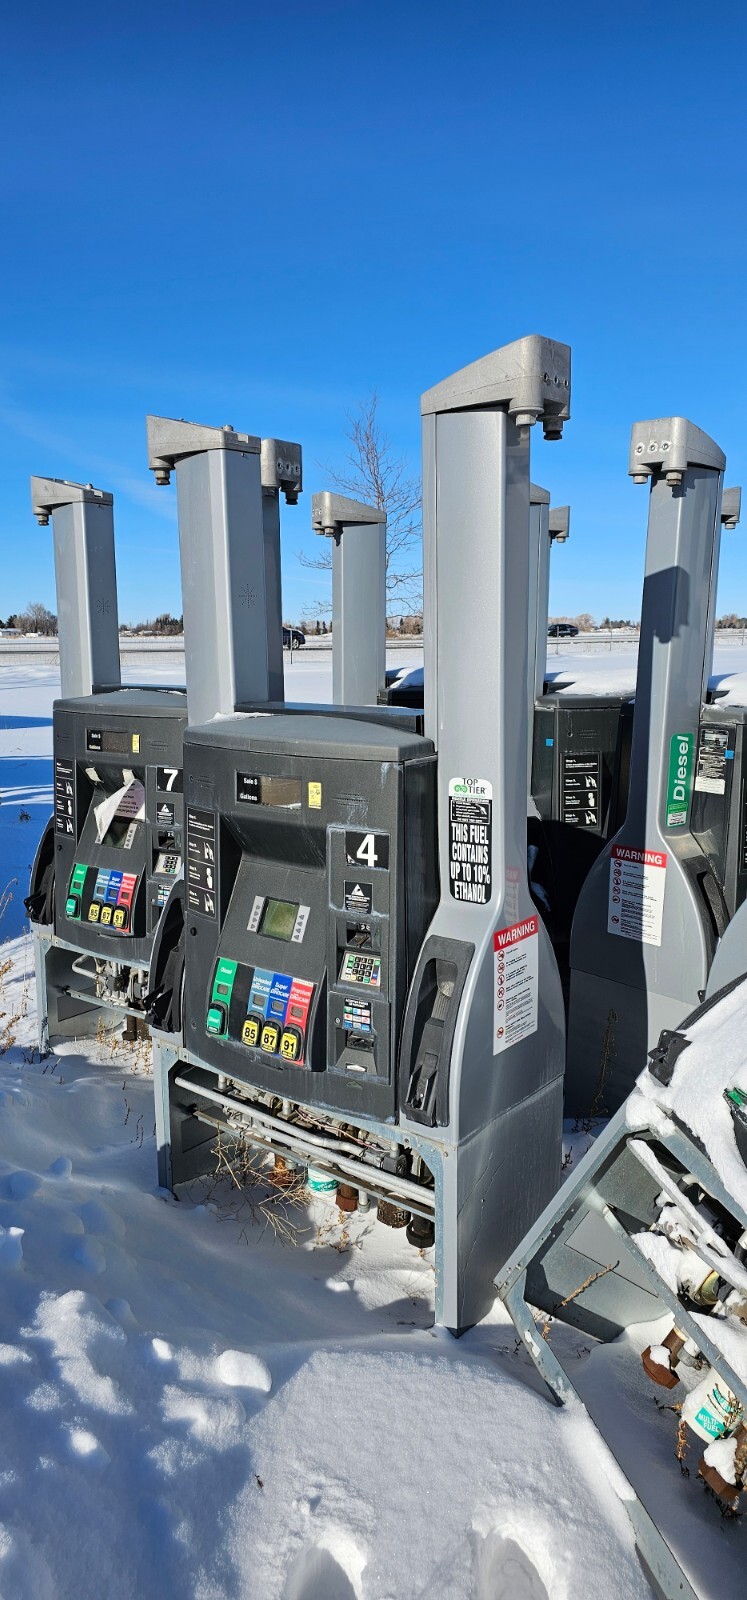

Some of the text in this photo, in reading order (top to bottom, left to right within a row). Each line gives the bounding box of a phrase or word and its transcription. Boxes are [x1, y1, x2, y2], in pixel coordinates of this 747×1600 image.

[673, 736, 689, 801] Diesel
[163, 769, 179, 791] 7
[462, 778, 478, 786] TOP
[240, 793, 258, 801] Gallons
[468, 786, 485, 794] TIER
[452, 822, 489, 844] THIS FUEL
[356, 834, 378, 867] 4
[452, 842, 488, 864] CONTAINS
[616, 848, 662, 865] WARNING
[450, 861, 490, 884] UP TO 10%
[454, 881, 486, 903] ETHANOL
[498, 920, 535, 946] WARNING
[275, 982, 288, 990] Super
[244, 1027, 256, 1039] 85
[264, 1034, 275, 1046] 87
[284, 1040, 294, 1052] 91
[704, 1421, 719, 1432] FUEL
